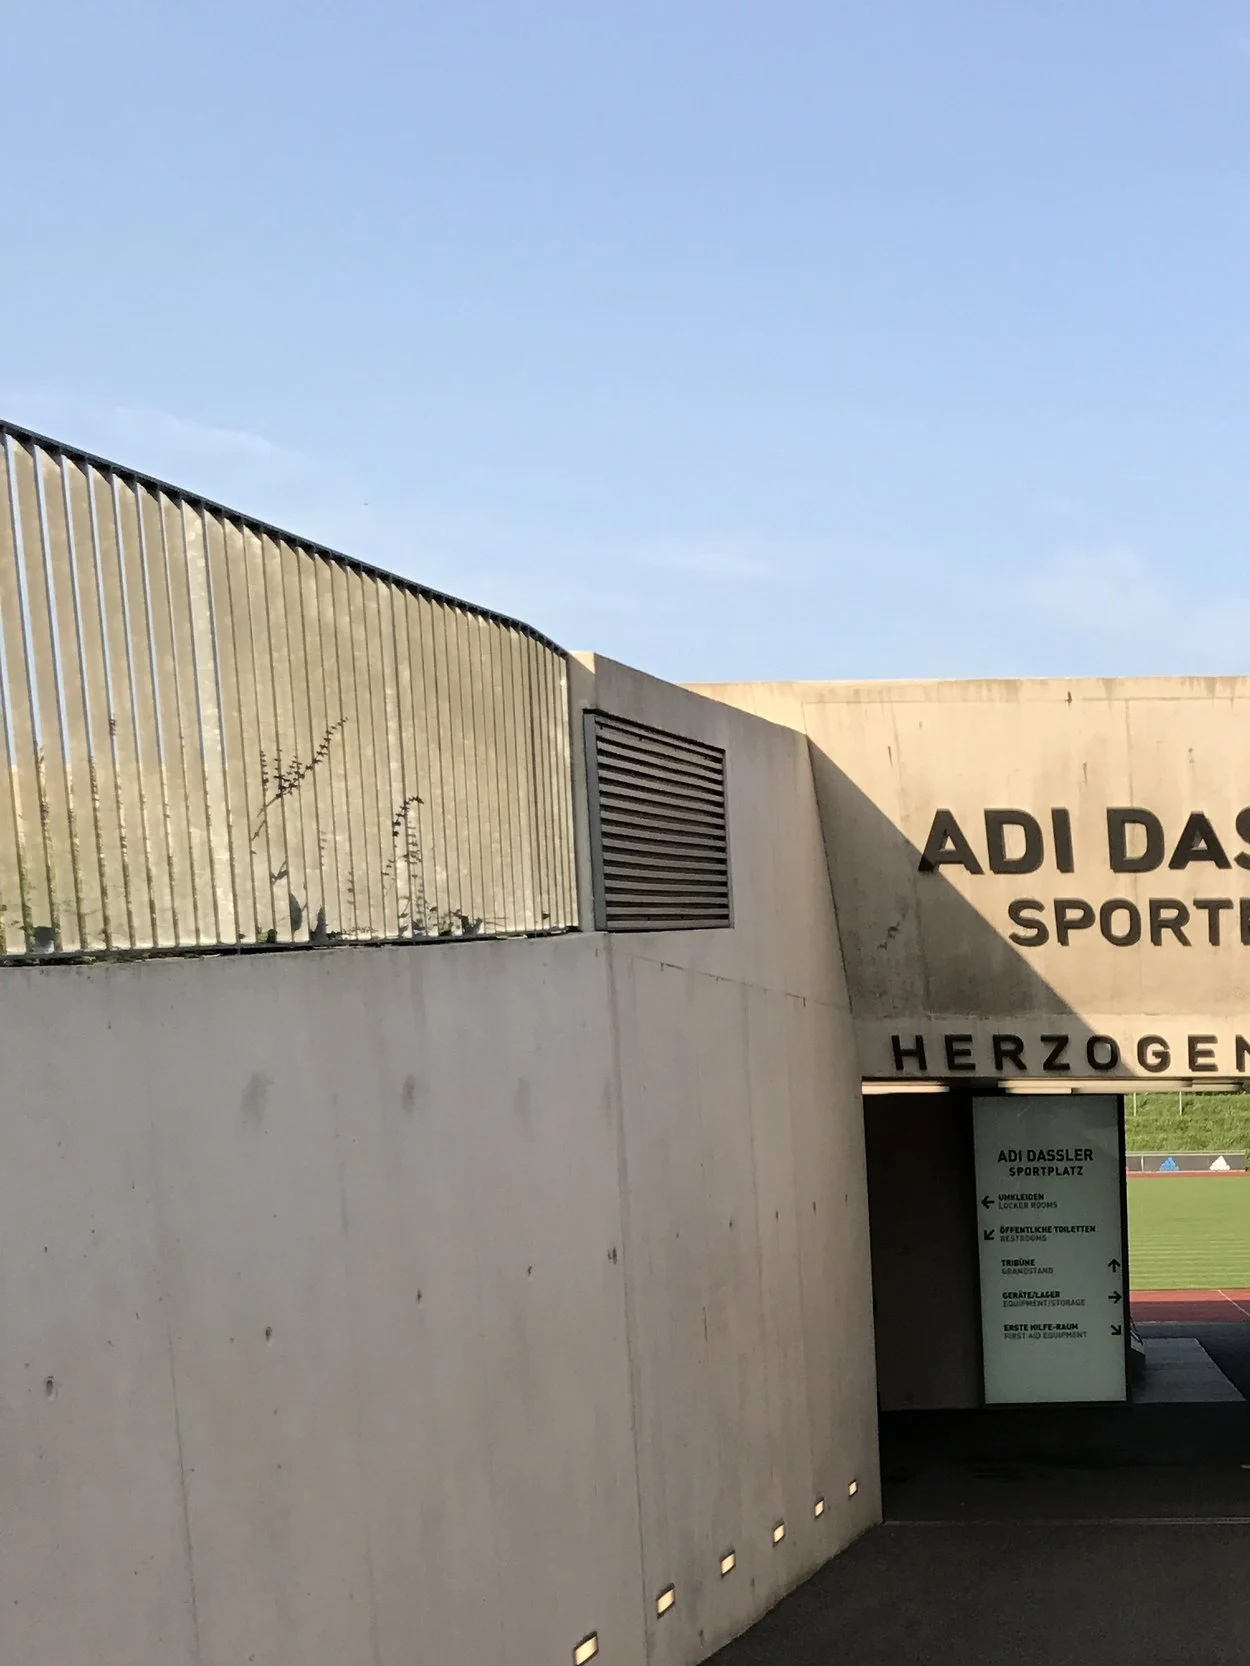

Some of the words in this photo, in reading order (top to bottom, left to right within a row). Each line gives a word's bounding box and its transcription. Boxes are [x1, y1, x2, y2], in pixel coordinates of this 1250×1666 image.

[918, 806, 1075, 875] ADI
[997, 1149, 1022, 1163] ADI
[1027, 1148, 1094, 1162] DASSLER
[1008, 1166, 1084, 1177] SPORTPLATZ
[998, 1193, 1044, 1201] UMKLEIDEN
[998, 1202, 1029, 1210] LOCKER
[1030, 1201, 1058, 1209] ROOMS
[1000, 1225, 1053, 1234] ÖFFENTLICHE
[1054, 1225, 1096, 1233] TOILETTEN
[1000, 1234, 1047, 1242] RESTROOMS
[1001, 1258, 1035, 1267] TRIBÜNE
[1001, 1267, 1054, 1275] GRANDSTAND
[1002, 1290, 1061, 1299] GERÄTE/LAGER
[1002, 1299, 1086, 1308] EQUIPMENT/STORAGE
[1004, 1324, 1029, 1332] ERSTE
[1030, 1323, 1079, 1331] HILFE-RAUM
[1004, 1332, 1026, 1340] FIRST
[1043, 1331, 1087, 1339] EQUIPMENT
